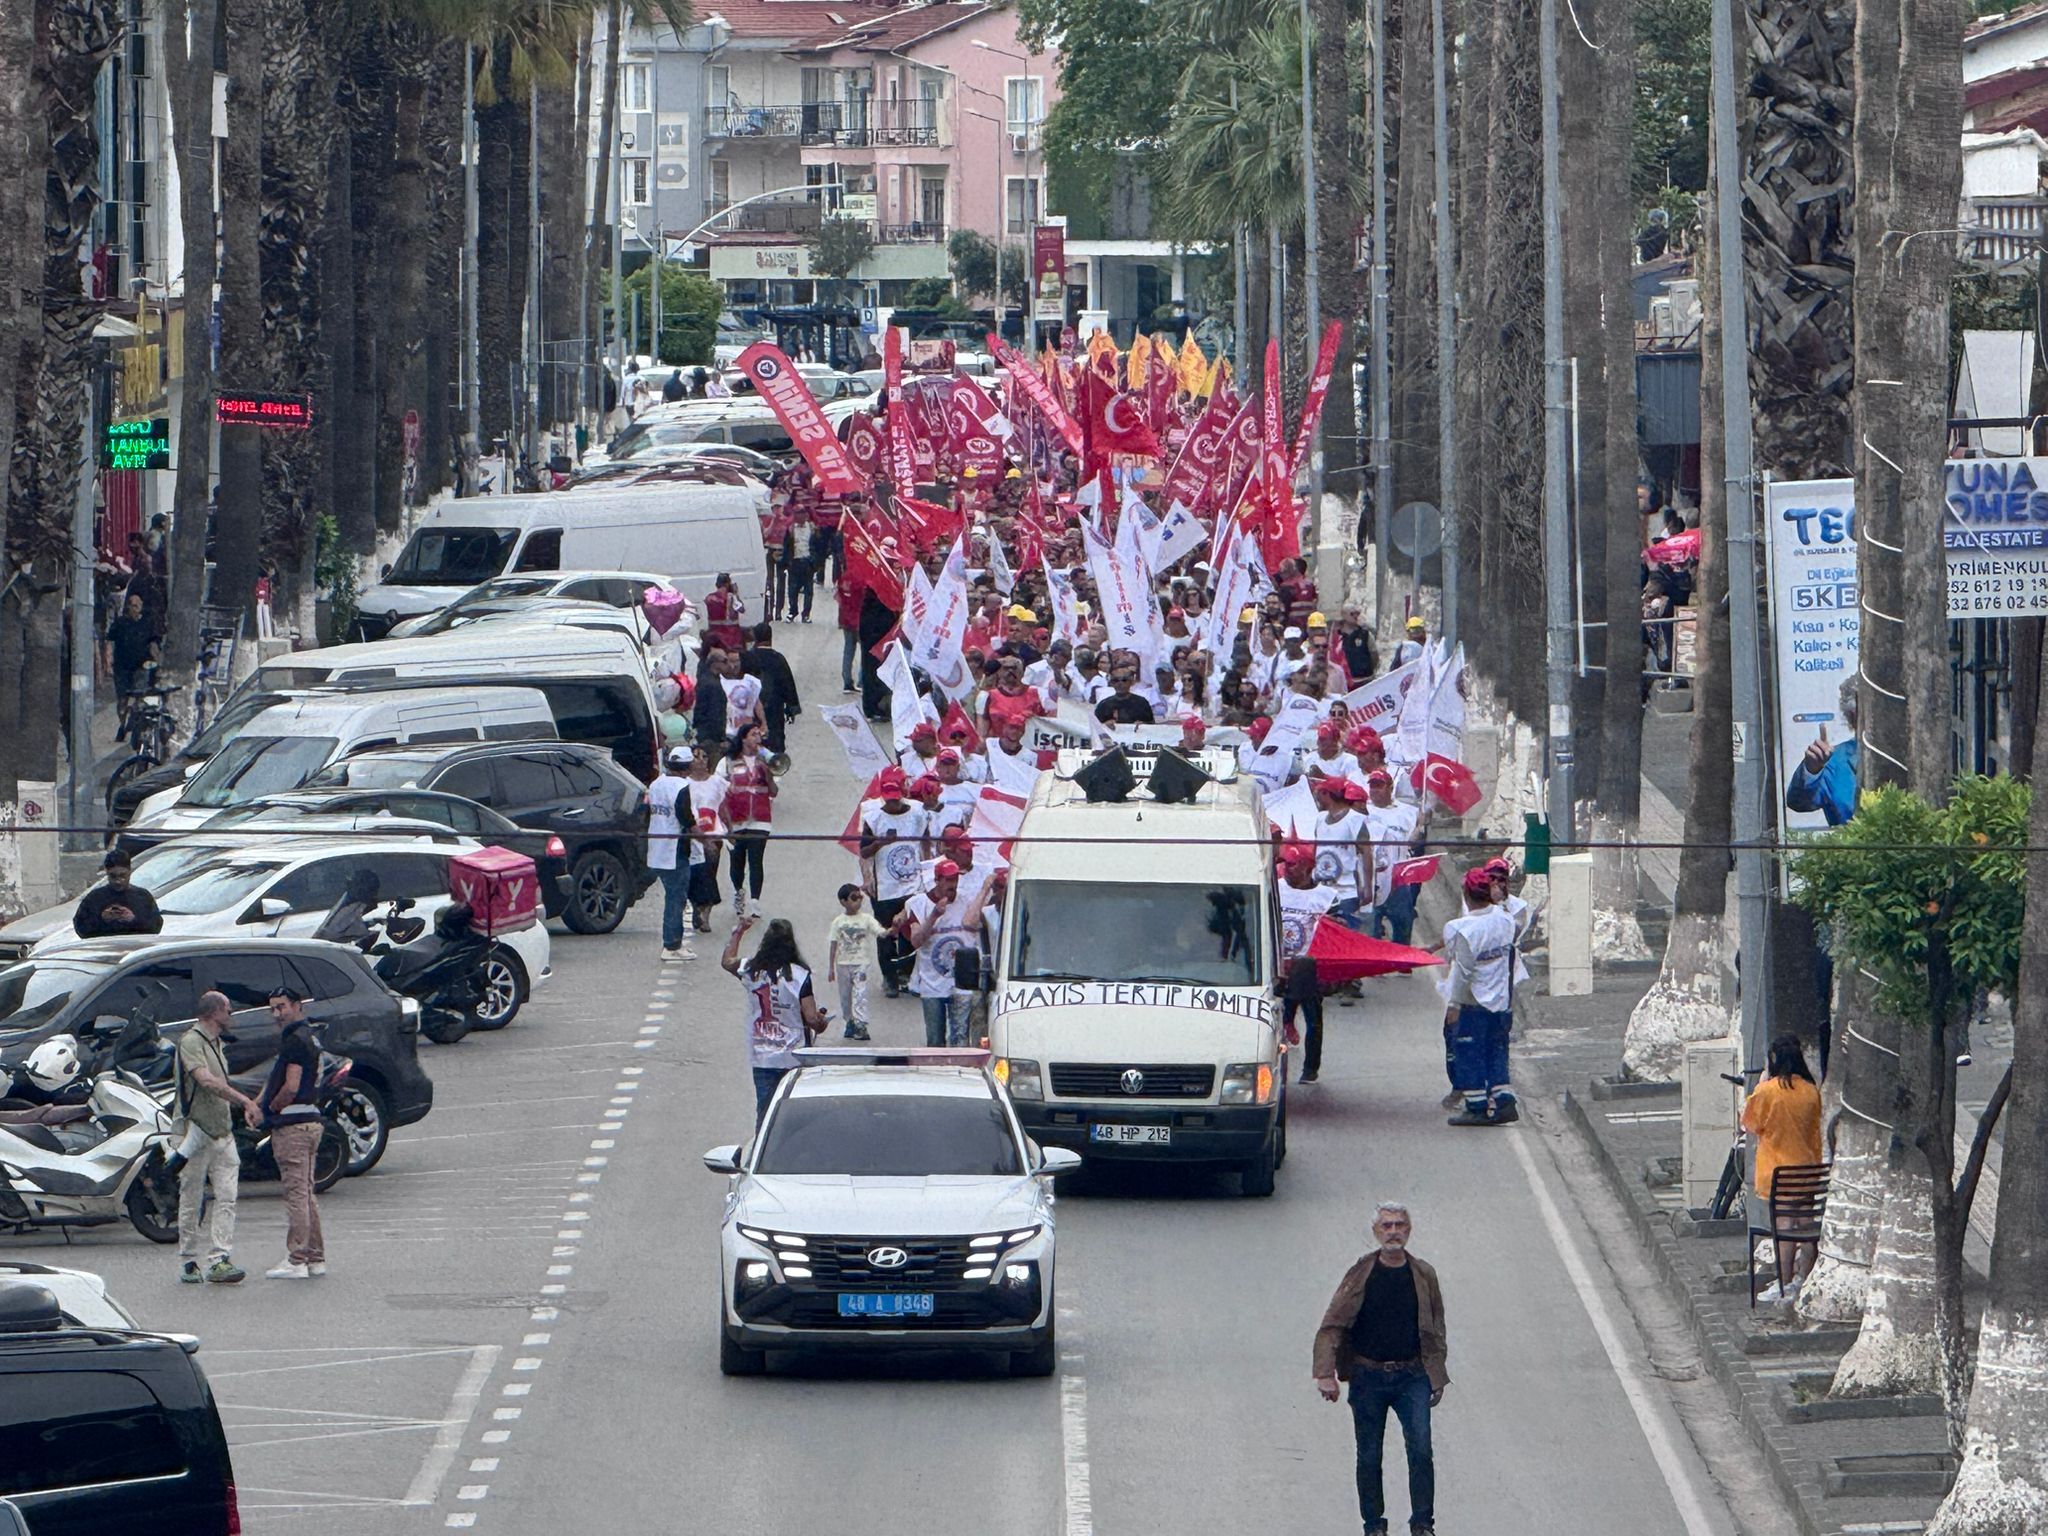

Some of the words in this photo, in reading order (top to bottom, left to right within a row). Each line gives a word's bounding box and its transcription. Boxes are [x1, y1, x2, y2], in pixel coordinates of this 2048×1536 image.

[1945, 491, 2048, 523] OMES
[1944, 533, 1975, 548] EAL
[1979, 530, 2043, 547] ESTATE
[1974, 579, 2001, 593] 612
[2007, 595, 2025, 609] 02
[1120, 1126, 1140, 1140] HP
[876, 1294, 883, 1311] A
